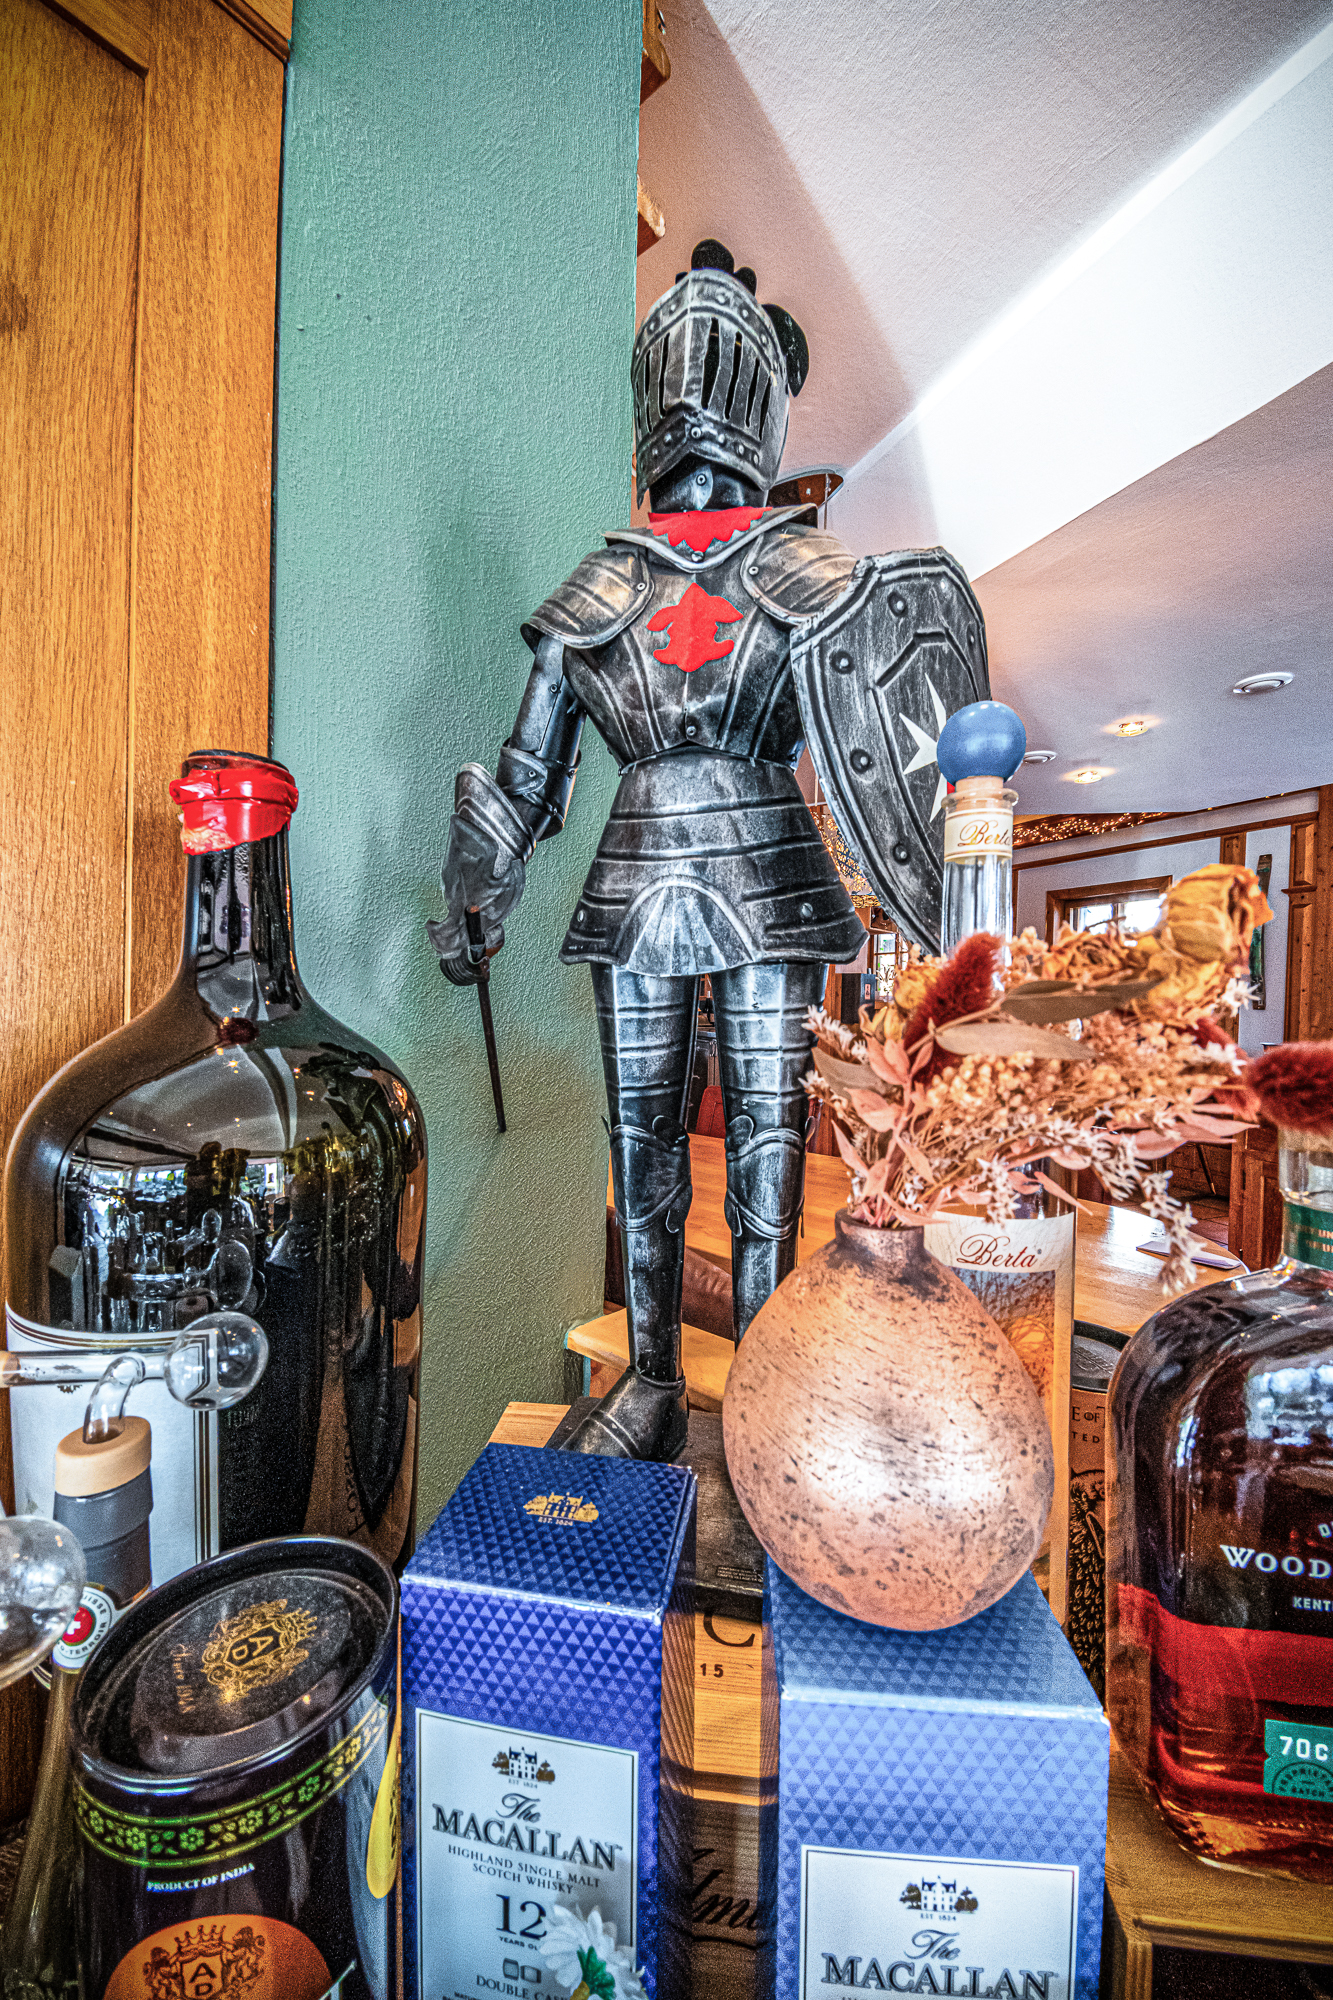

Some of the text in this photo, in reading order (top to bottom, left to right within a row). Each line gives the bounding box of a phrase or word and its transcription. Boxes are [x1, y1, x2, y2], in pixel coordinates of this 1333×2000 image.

[957, 819, 1011, 847] Berta
[956, 1233, 1037, 1268] Berta
[231, 1644, 249, 1661] D
[248, 1635, 274, 1657] A
[495, 1793, 541, 1823] The
[432, 1803, 616, 1871] MACALLAN
[146, 1862, 255, 1892] PRODUCT OF INDIA
[448, 1845, 601, 1888] HIGHLAND SINGLE MALT
[472, 1863, 574, 1895] SCOTCH WHISKY
[495, 1893, 548, 1940] 12
[499, 1935, 525, 1948] YEARS
[903, 1929, 961, 1960] The
[189, 1962, 217, 1985] A
[476, 1974, 530, 1999] DOUBLE
[821, 1952, 1055, 2000] MACALLAN
